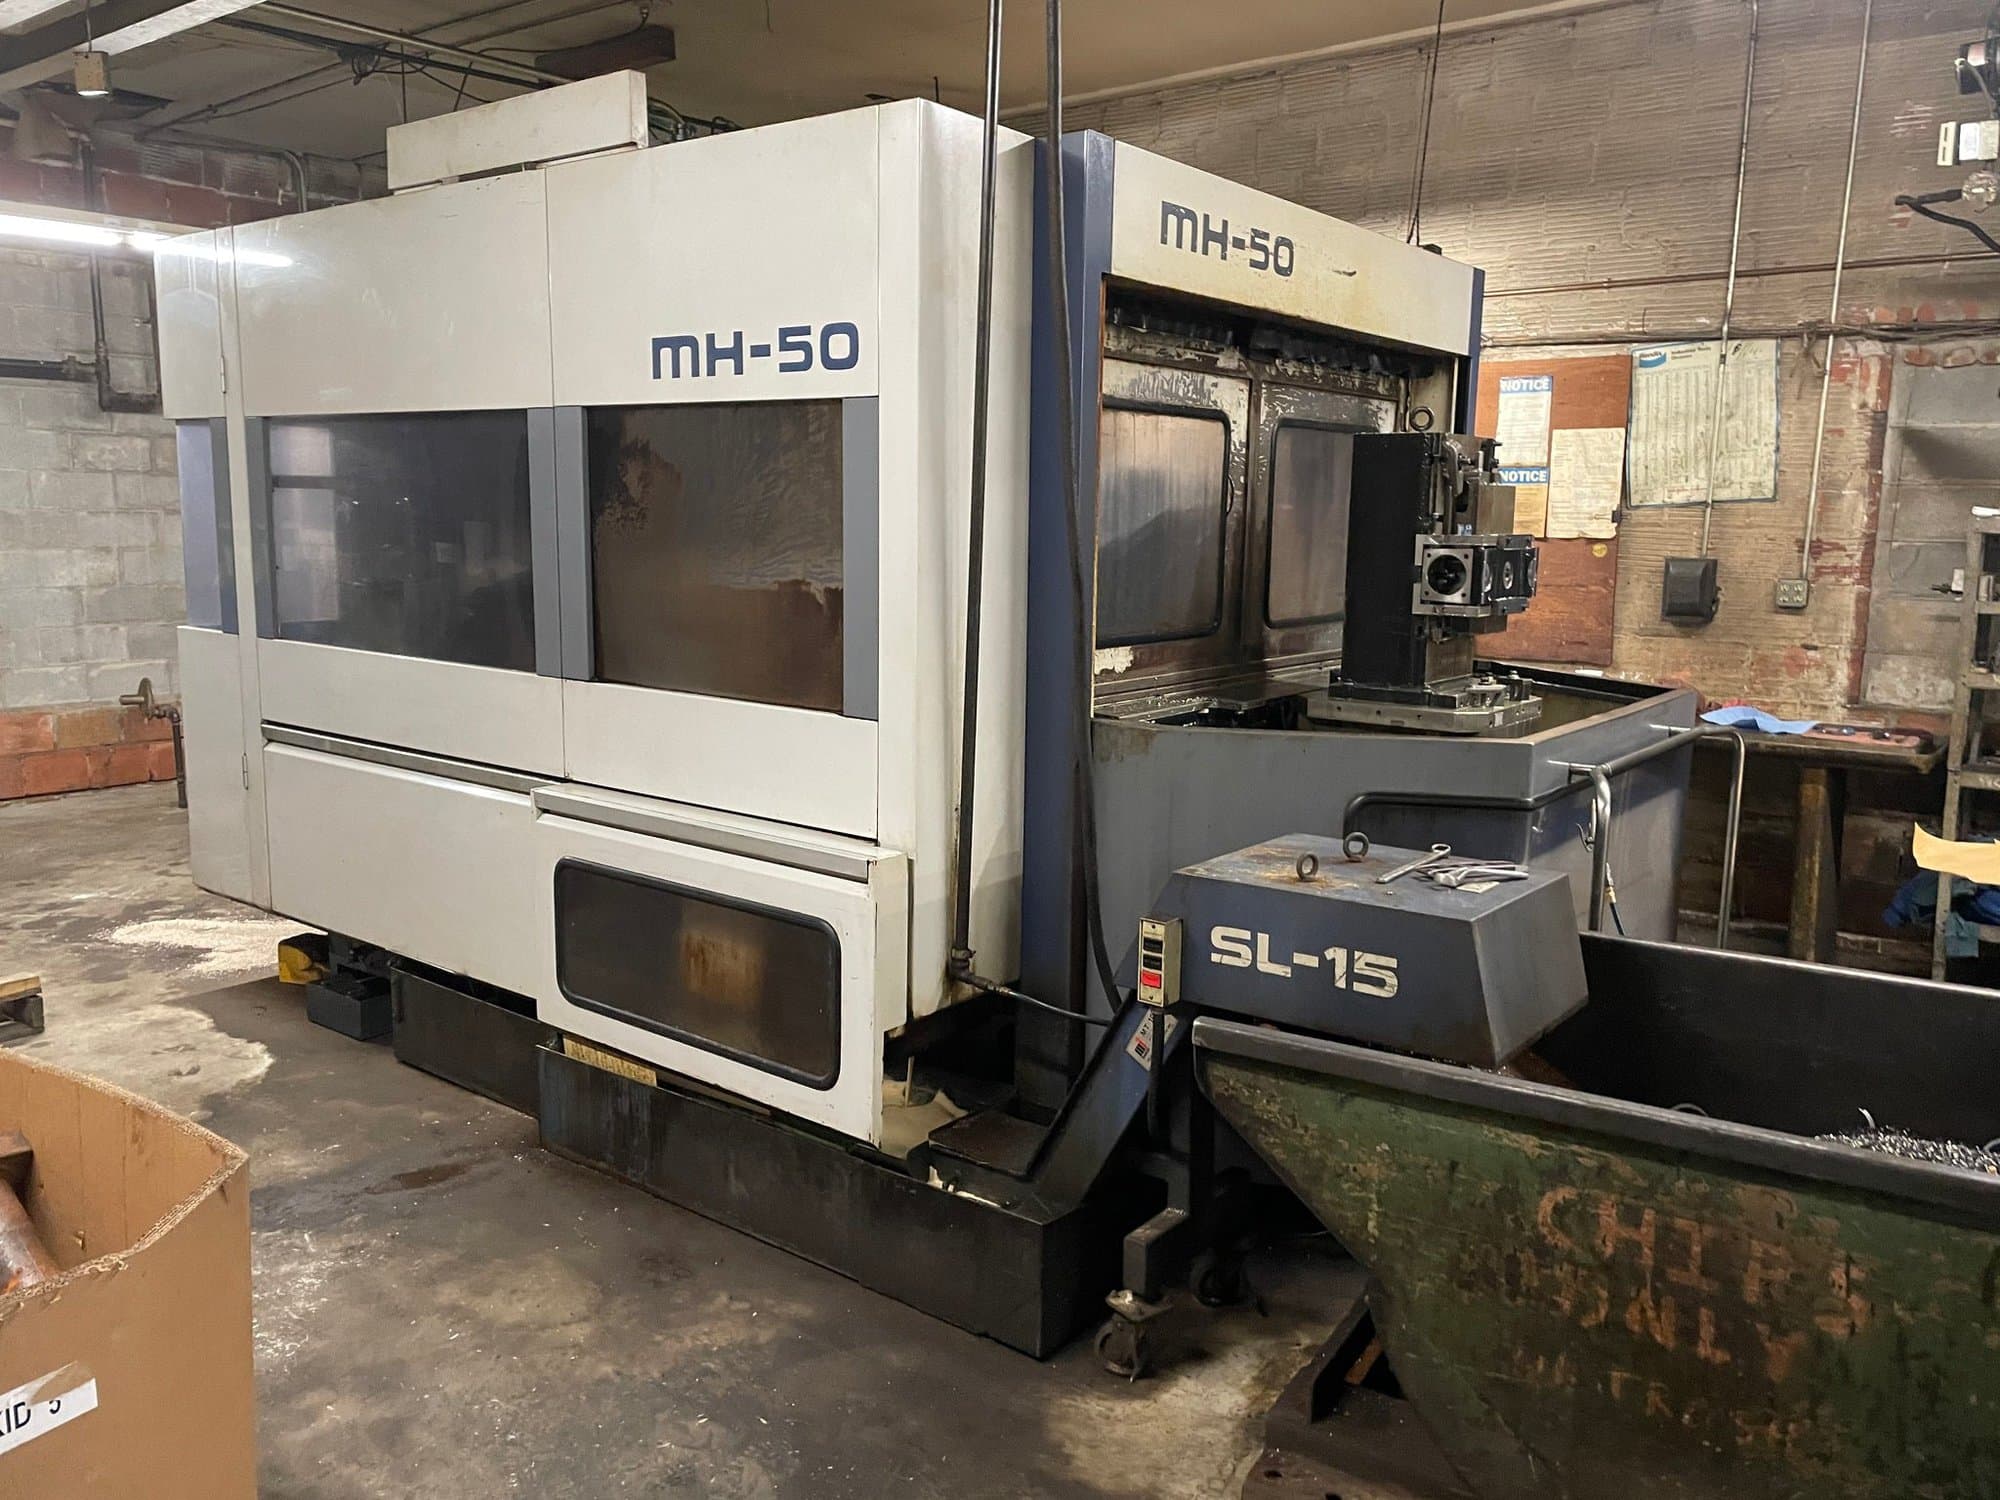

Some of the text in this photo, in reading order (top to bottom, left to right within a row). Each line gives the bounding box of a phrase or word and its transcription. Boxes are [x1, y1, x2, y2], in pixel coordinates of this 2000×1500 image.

[1500, 378, 1550, 392] NOTICE
[1498, 470, 1547, 482] NOTICE
[1211, 926, 1398, 998] SL-15
[0, 1401, 31, 1437] ID
